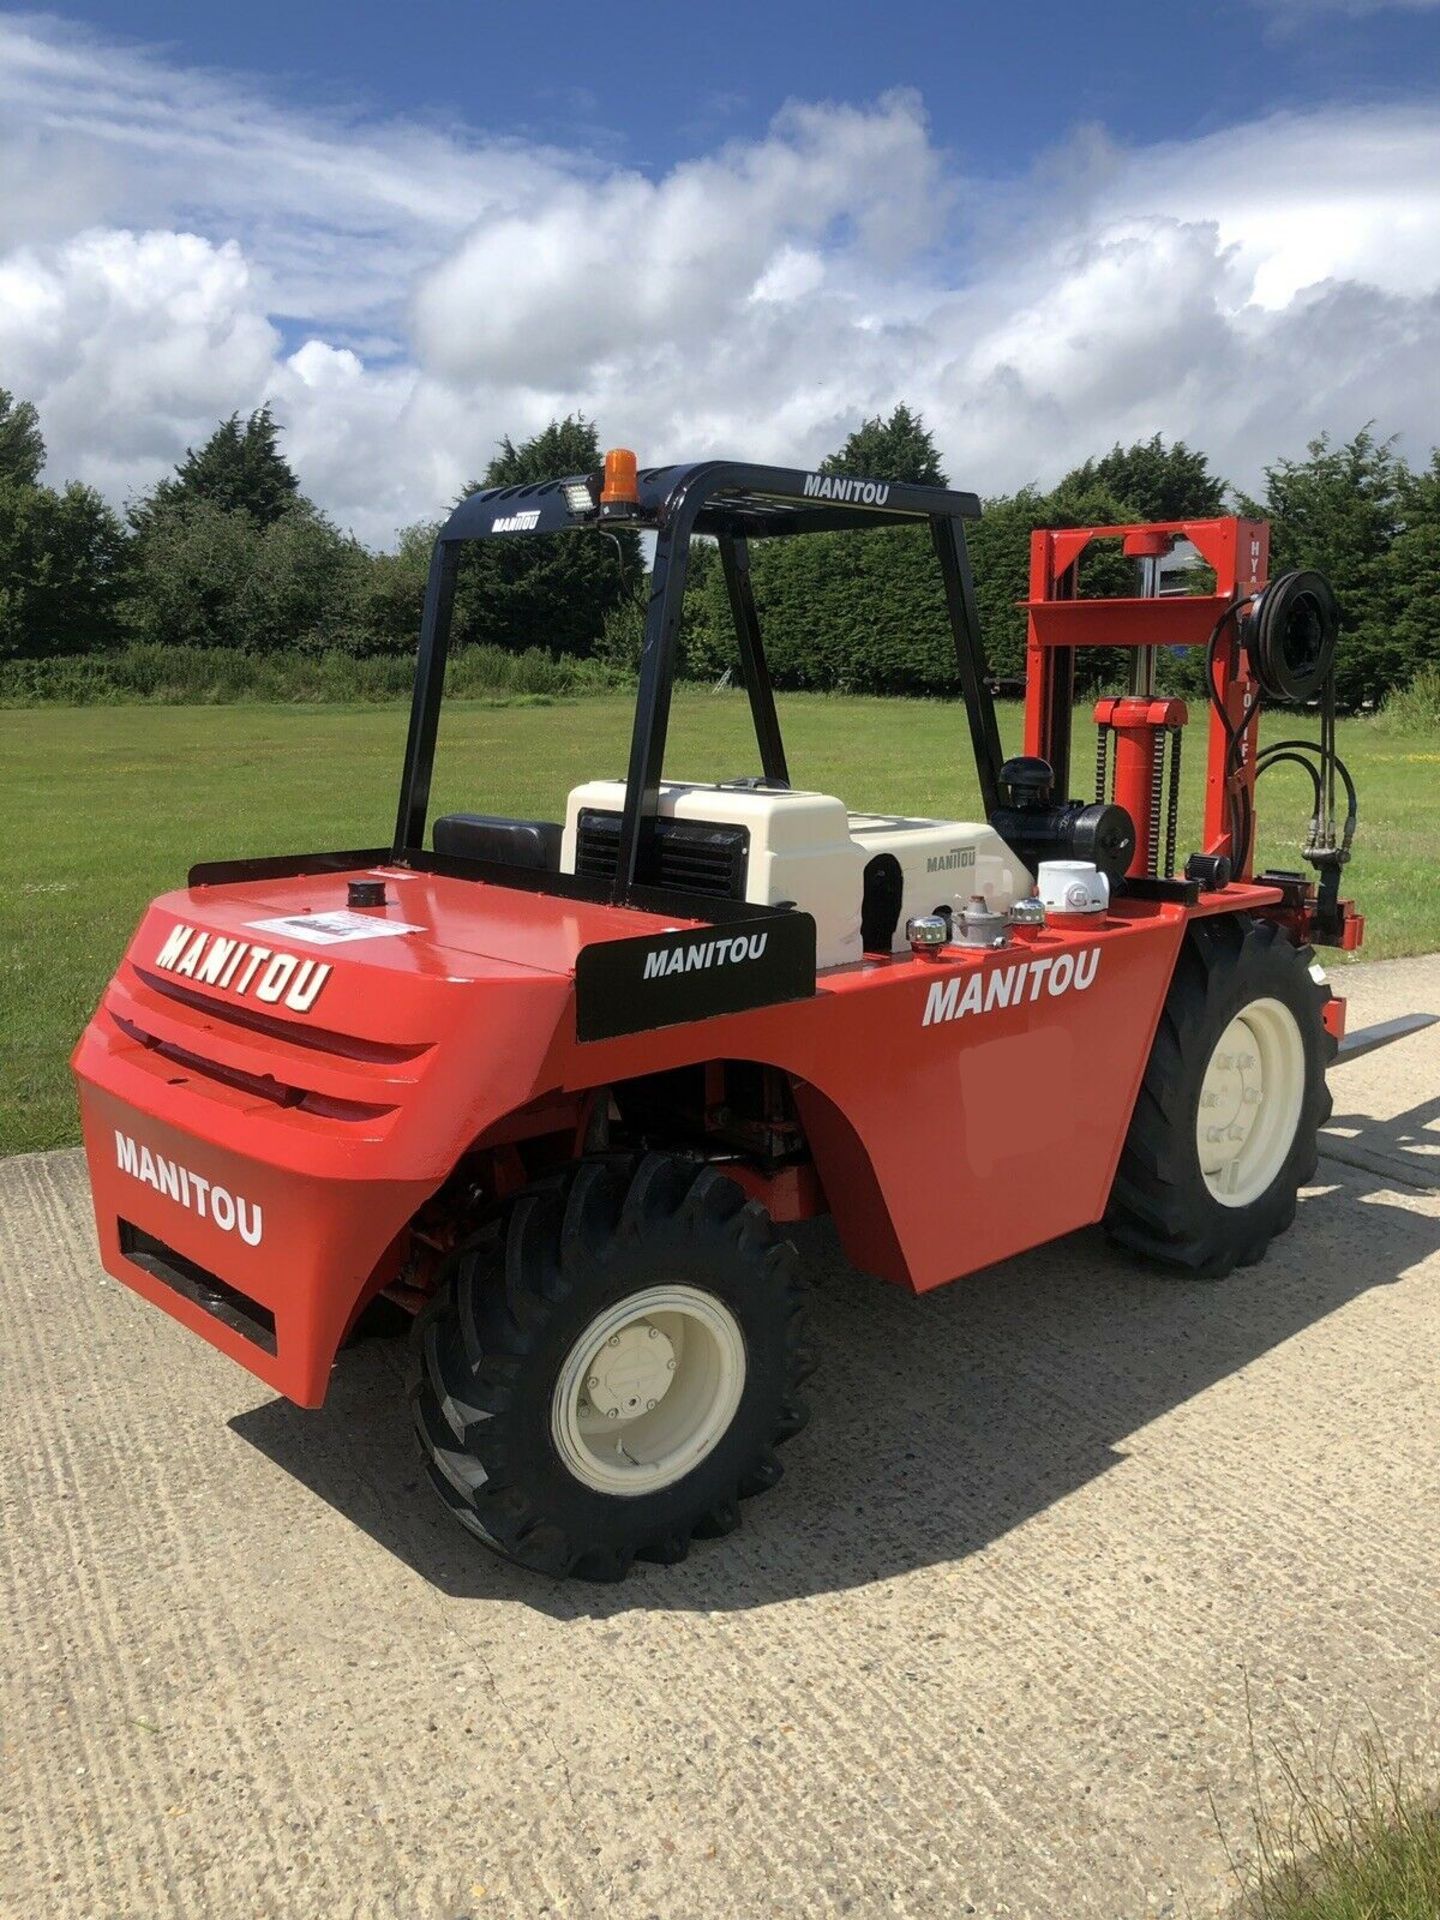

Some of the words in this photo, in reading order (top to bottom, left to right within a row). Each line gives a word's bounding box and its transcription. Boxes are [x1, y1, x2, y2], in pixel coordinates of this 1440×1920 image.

[803, 474, 890, 505] MANITOU
[491, 510, 541, 533] MANITOU
[927, 846, 976, 873] MANITOU
[156, 923, 333, 1013] MANITOU
[643, 933, 768, 979] MANITOU
[922, 948, 1101, 1027] MANITOU
[115, 1130, 262, 1247] MANITOU
